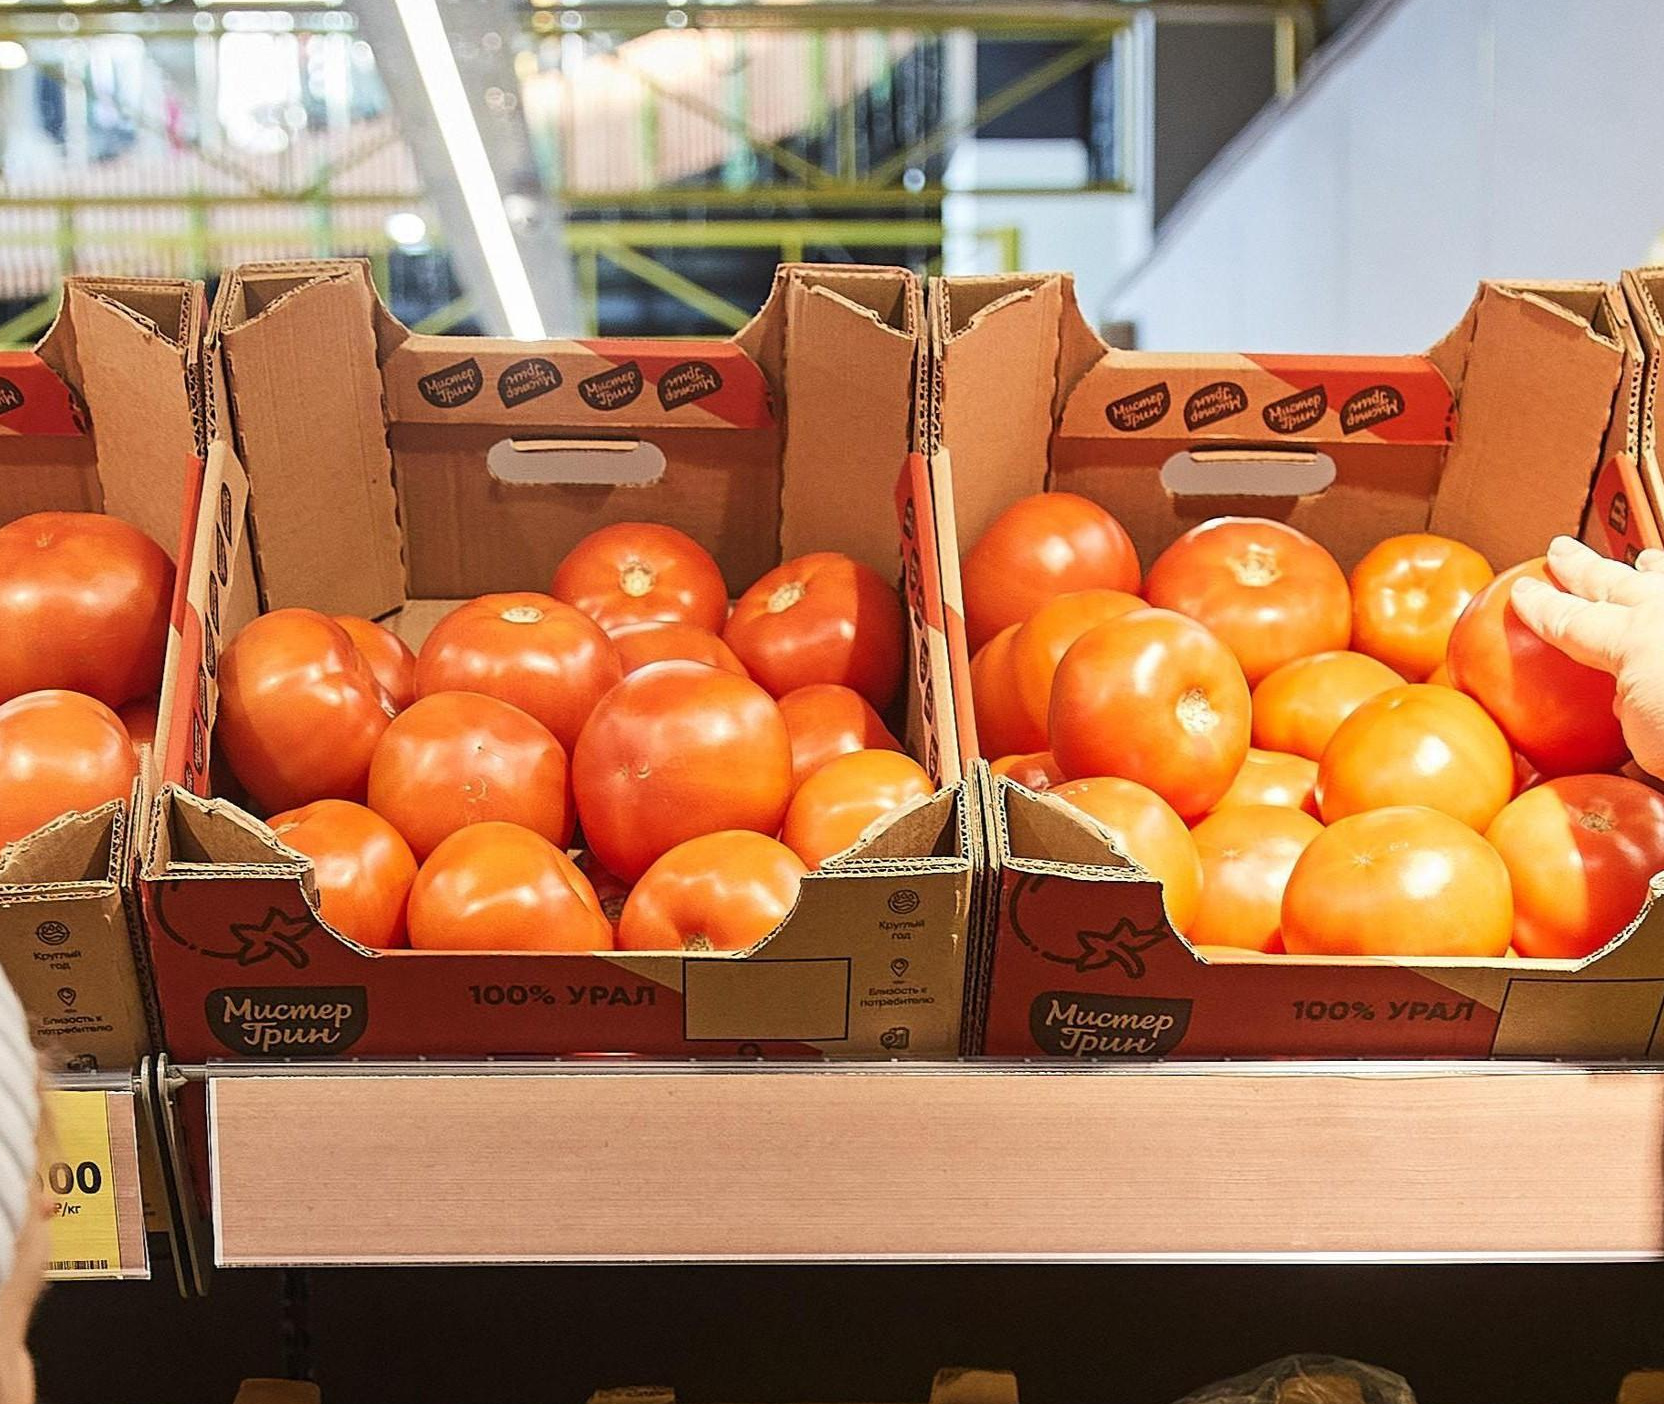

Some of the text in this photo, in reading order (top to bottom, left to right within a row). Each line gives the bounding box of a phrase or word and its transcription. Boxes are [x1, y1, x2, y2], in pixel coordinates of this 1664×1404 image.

[425, 369, 475, 396] Мистер
[437, 384, 476, 403] Грин
[585, 371, 636, 398] Мистер
[596, 384, 636, 407] Грин
[1112, 392, 1164, 420] Мистер
[1123, 406, 1163, 428] Грин
[1268, 395, 1322, 422] Мистер
[1280, 408, 1318, 431] Грин
[468, 984, 657, 1007] 100% УРАЛ
[224, 995, 352, 1026] Мистер
[1046, 1000, 1174, 1033] Мистер
[1291, 1000, 1477, 1022] 100% УРАЛ
[243, 1020, 340, 1052] Грин
[1059, 1027, 1156, 1058] Грин
